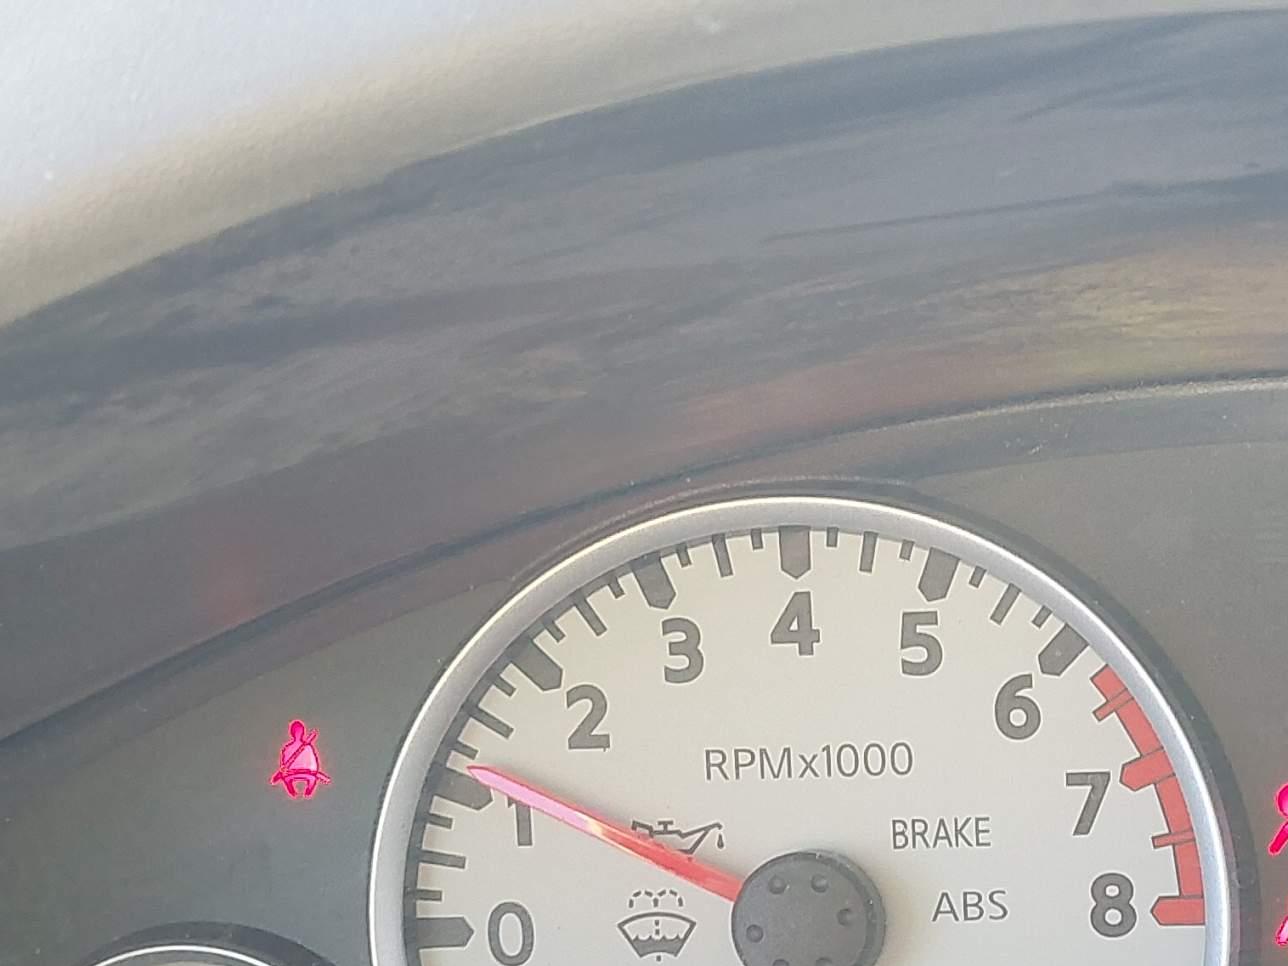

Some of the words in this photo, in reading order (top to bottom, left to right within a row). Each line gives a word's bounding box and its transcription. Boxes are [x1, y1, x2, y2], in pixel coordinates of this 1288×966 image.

[663, 618, 705, 683] 3
[770, 591, 821, 655] 4
[900, 612, 944, 676] 5
[566, 685, 611, 751] 2
[995, 675, 1041, 740] 6
[892, 818, 991, 849] BRAKE
[1066, 772, 1110, 835] 7
[487, 902, 535, 966] 0
[933, 890, 1008, 922] ABS
[1090, 873, 1136, 938] 8
